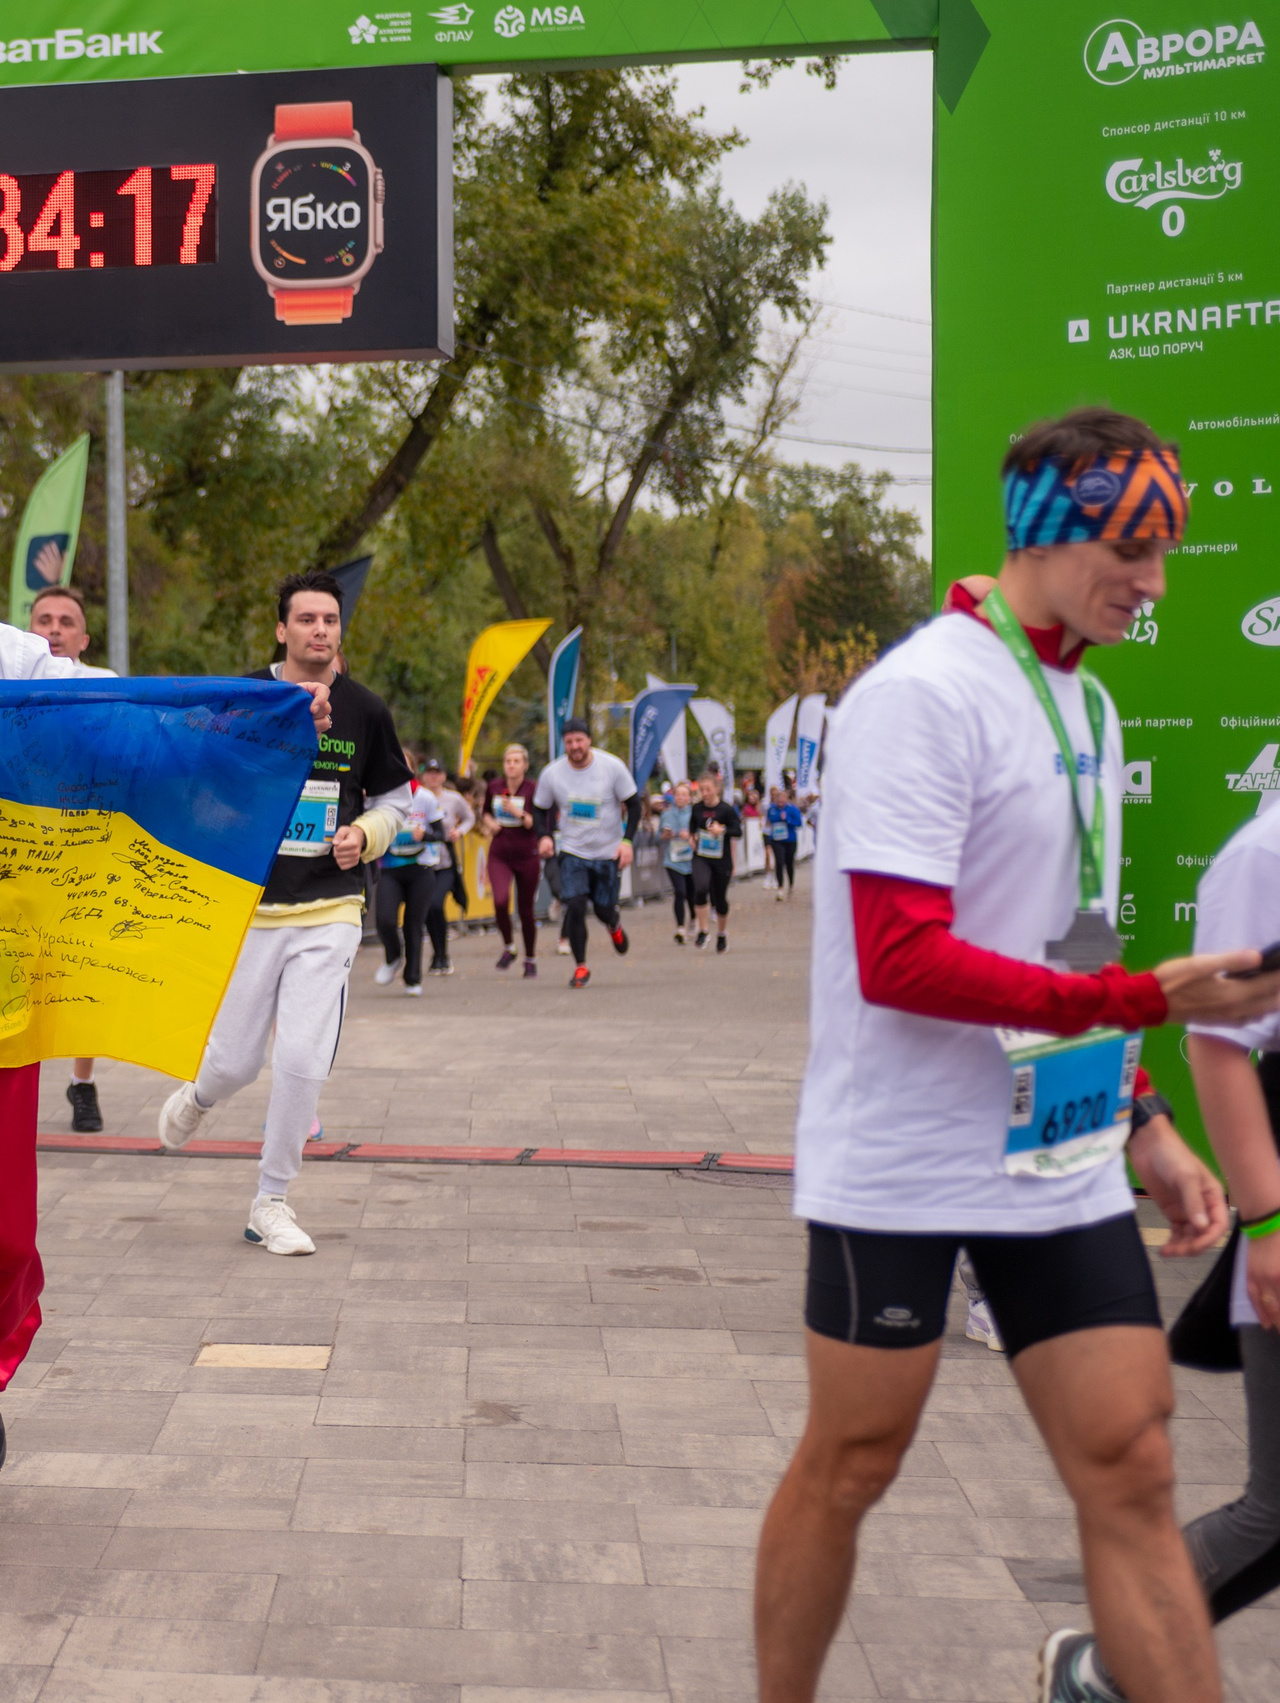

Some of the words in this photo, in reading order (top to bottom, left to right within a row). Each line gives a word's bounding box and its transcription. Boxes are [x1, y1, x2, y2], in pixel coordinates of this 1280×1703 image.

[531, 5, 585, 26] MSA
[1143, 52, 1265, 80] МУЛЬТИМАРКЕТ
[1101, 123, 1151, 138] Спонсор
[1154, 114, 1211, 133] дистанції
[1214, 110, 1228, 122] 10
[1230, 109, 1247, 120] км
[1105, 149, 1244, 211] Carlsberg
[265, 193, 361, 233] Ябко
[1106, 280, 1155, 296] Партнер
[1158, 275, 1215, 292] дистанції
[1217, 273, 1225, 283] 5
[1227, 273, 1244, 283] км
[1108, 300, 1280, 340] UKRNAFTA
[1109, 347, 1136, 361] АЗК,
[1138, 344, 1160, 359] ЩО
[1162, 340, 1205, 356] ПОРУЧ
[1188, 413, 1280, 431] Автомобільний
[1182, 478, 1272, 499] VOL
[1182, 543, 1238, 555] партнери
[1145, 717, 1193, 730] партнер
[318, 733, 356, 760] Group
[1041, 1090, 1109, 1145] 6920
